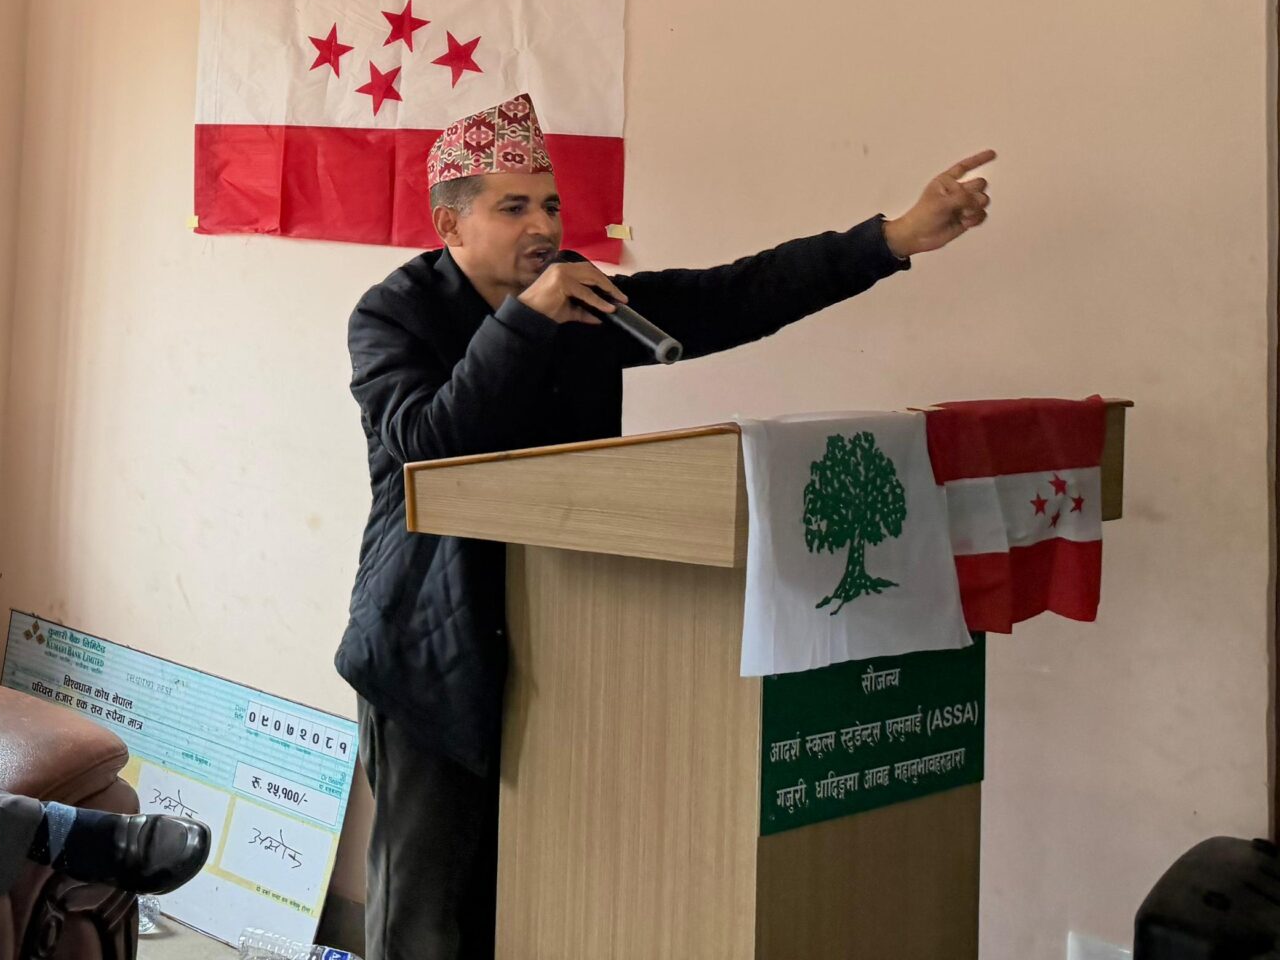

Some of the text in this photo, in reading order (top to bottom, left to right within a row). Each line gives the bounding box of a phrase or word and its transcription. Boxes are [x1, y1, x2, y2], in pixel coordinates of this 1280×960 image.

[861, 664, 902, 695] सौजन्य
[55, 691, 75, 706] हजार
[76, 698, 88, 710] एक
[90, 703, 104, 716] सय
[127, 717, 144, 731] मात्र
[112, 692, 133, 710] नेपाल
[770, 731, 802, 763] आदर्श
[926, 700, 979, 737] (ASSA)
